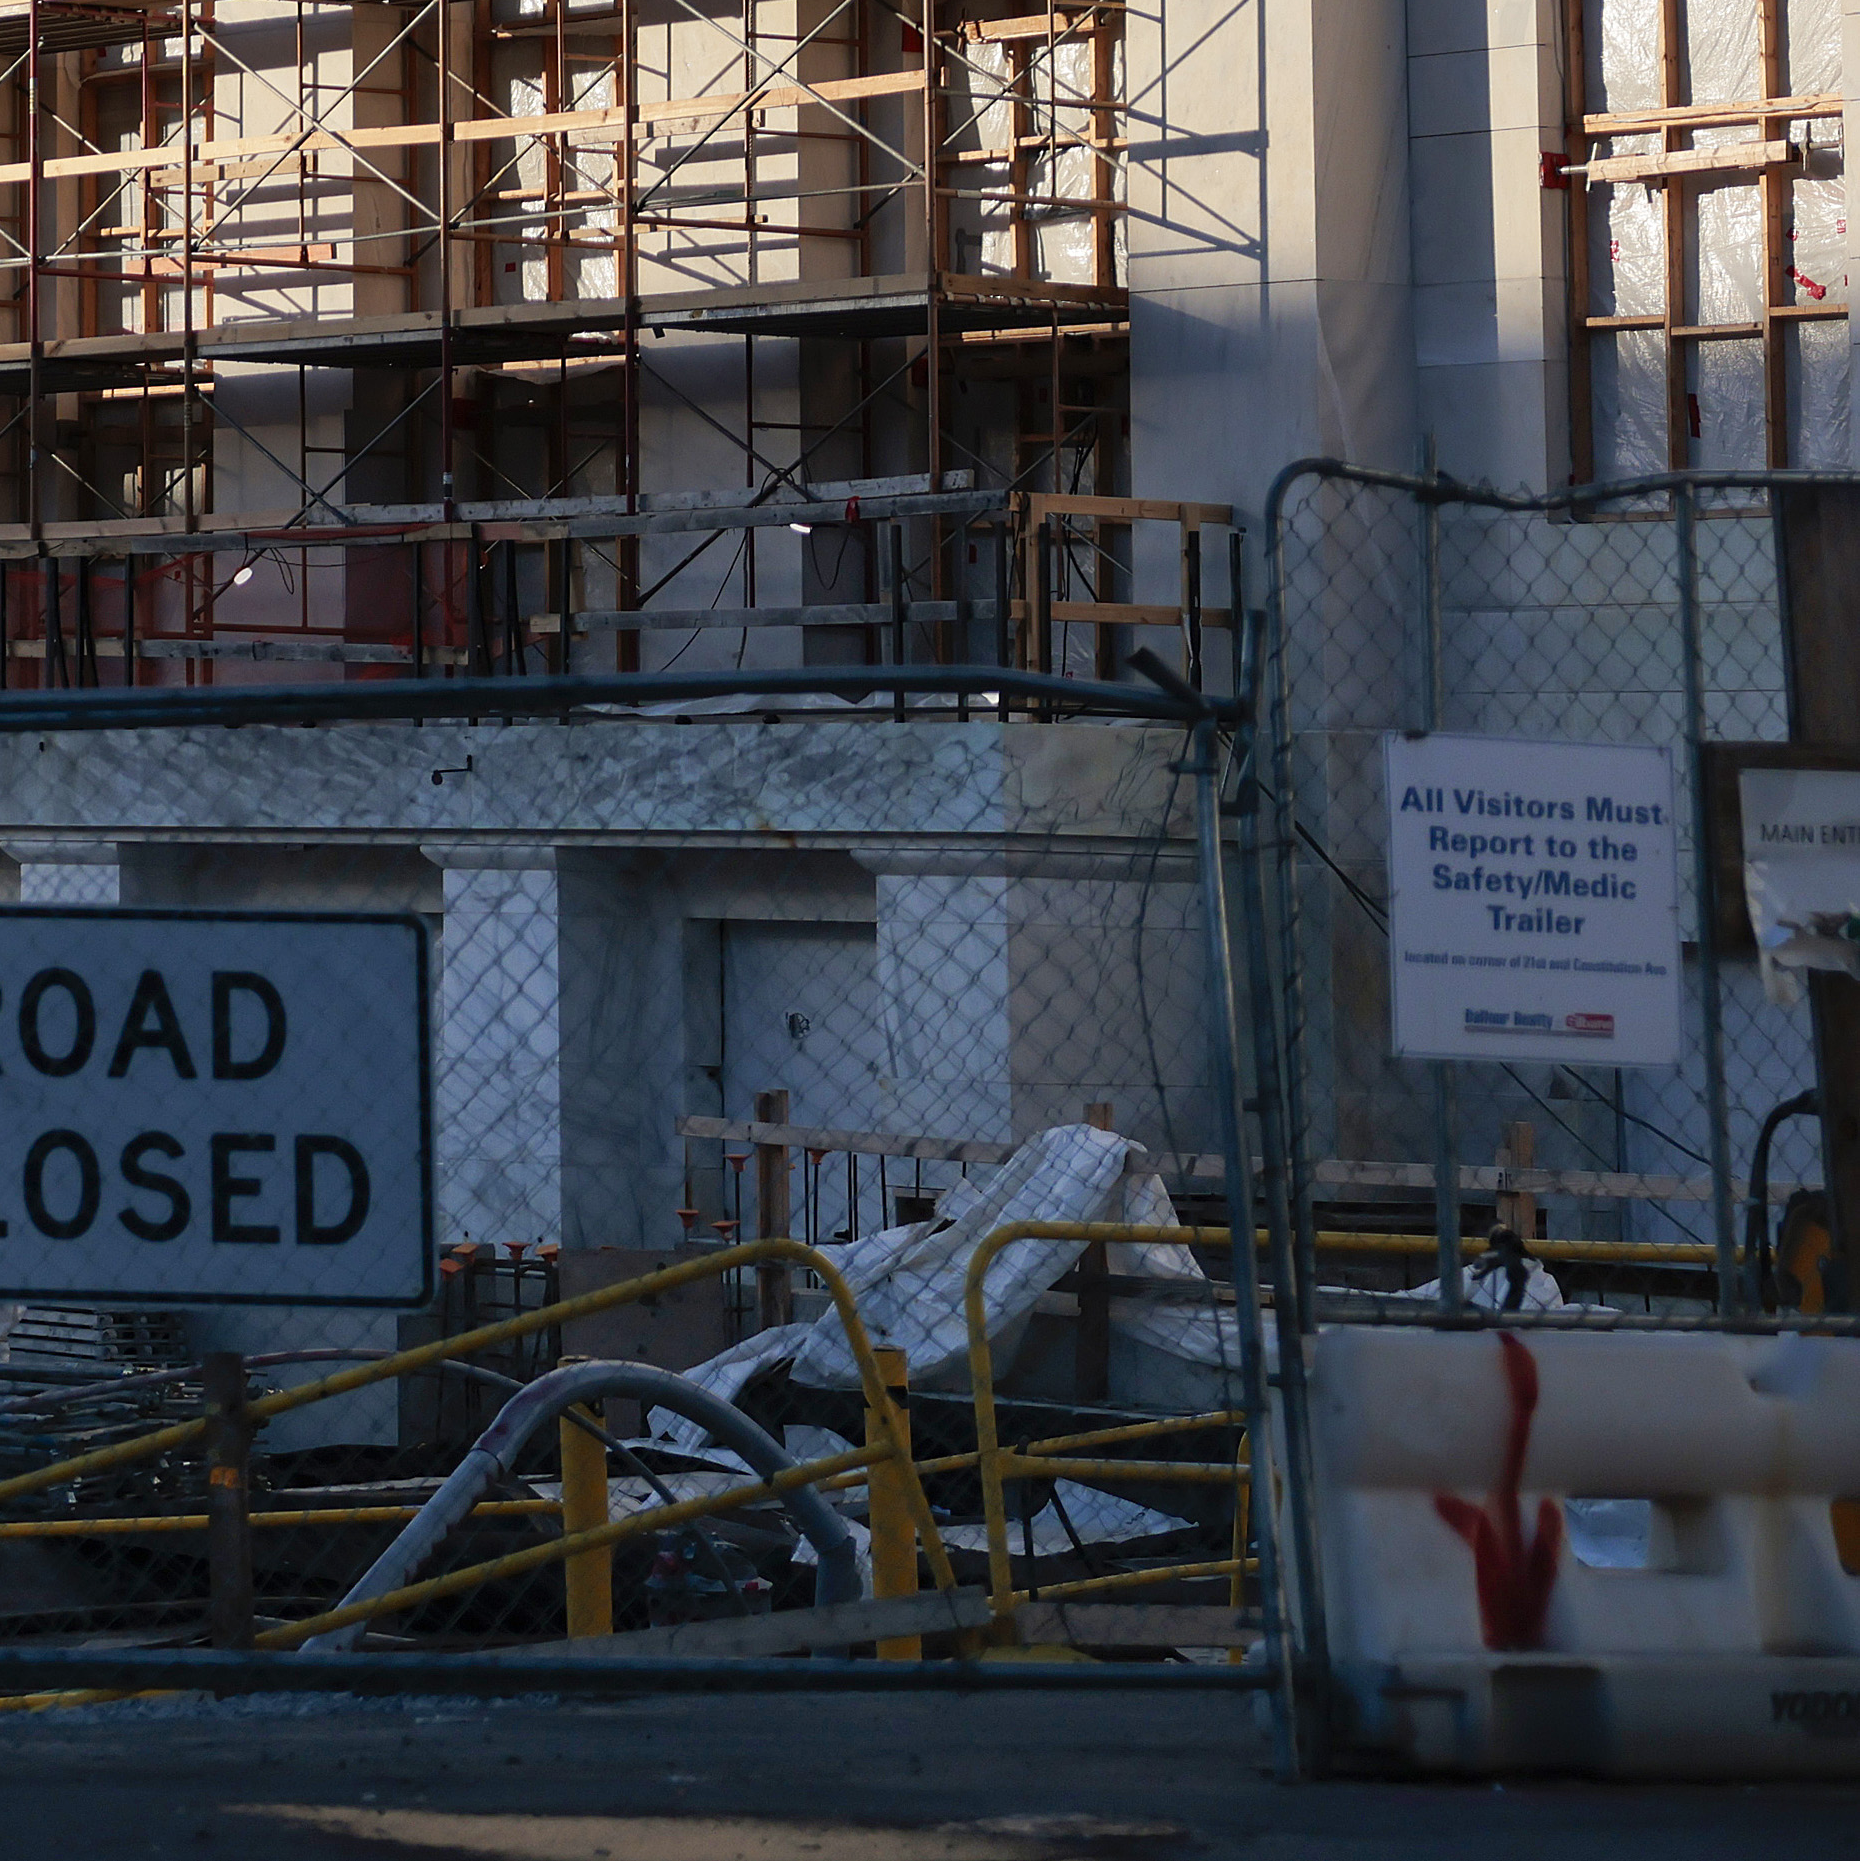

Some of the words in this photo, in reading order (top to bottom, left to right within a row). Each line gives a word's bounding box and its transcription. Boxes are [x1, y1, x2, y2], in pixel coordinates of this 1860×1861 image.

[1400, 786, 1444, 813] All
[1453, 789, 1575, 820] Visitors
[1586, 796, 1664, 826] Must
[1429, 825, 1535, 859] Report
[1545, 835, 1577, 858] to
[1588, 835, 1638, 862] the
[1760, 824, 1815, 844] MAIN
[1820, 825, 1860, 845] ENT
[1433, 863, 1637, 900] Safety/Medic
[1486, 905, 1585, 935] Trailer
